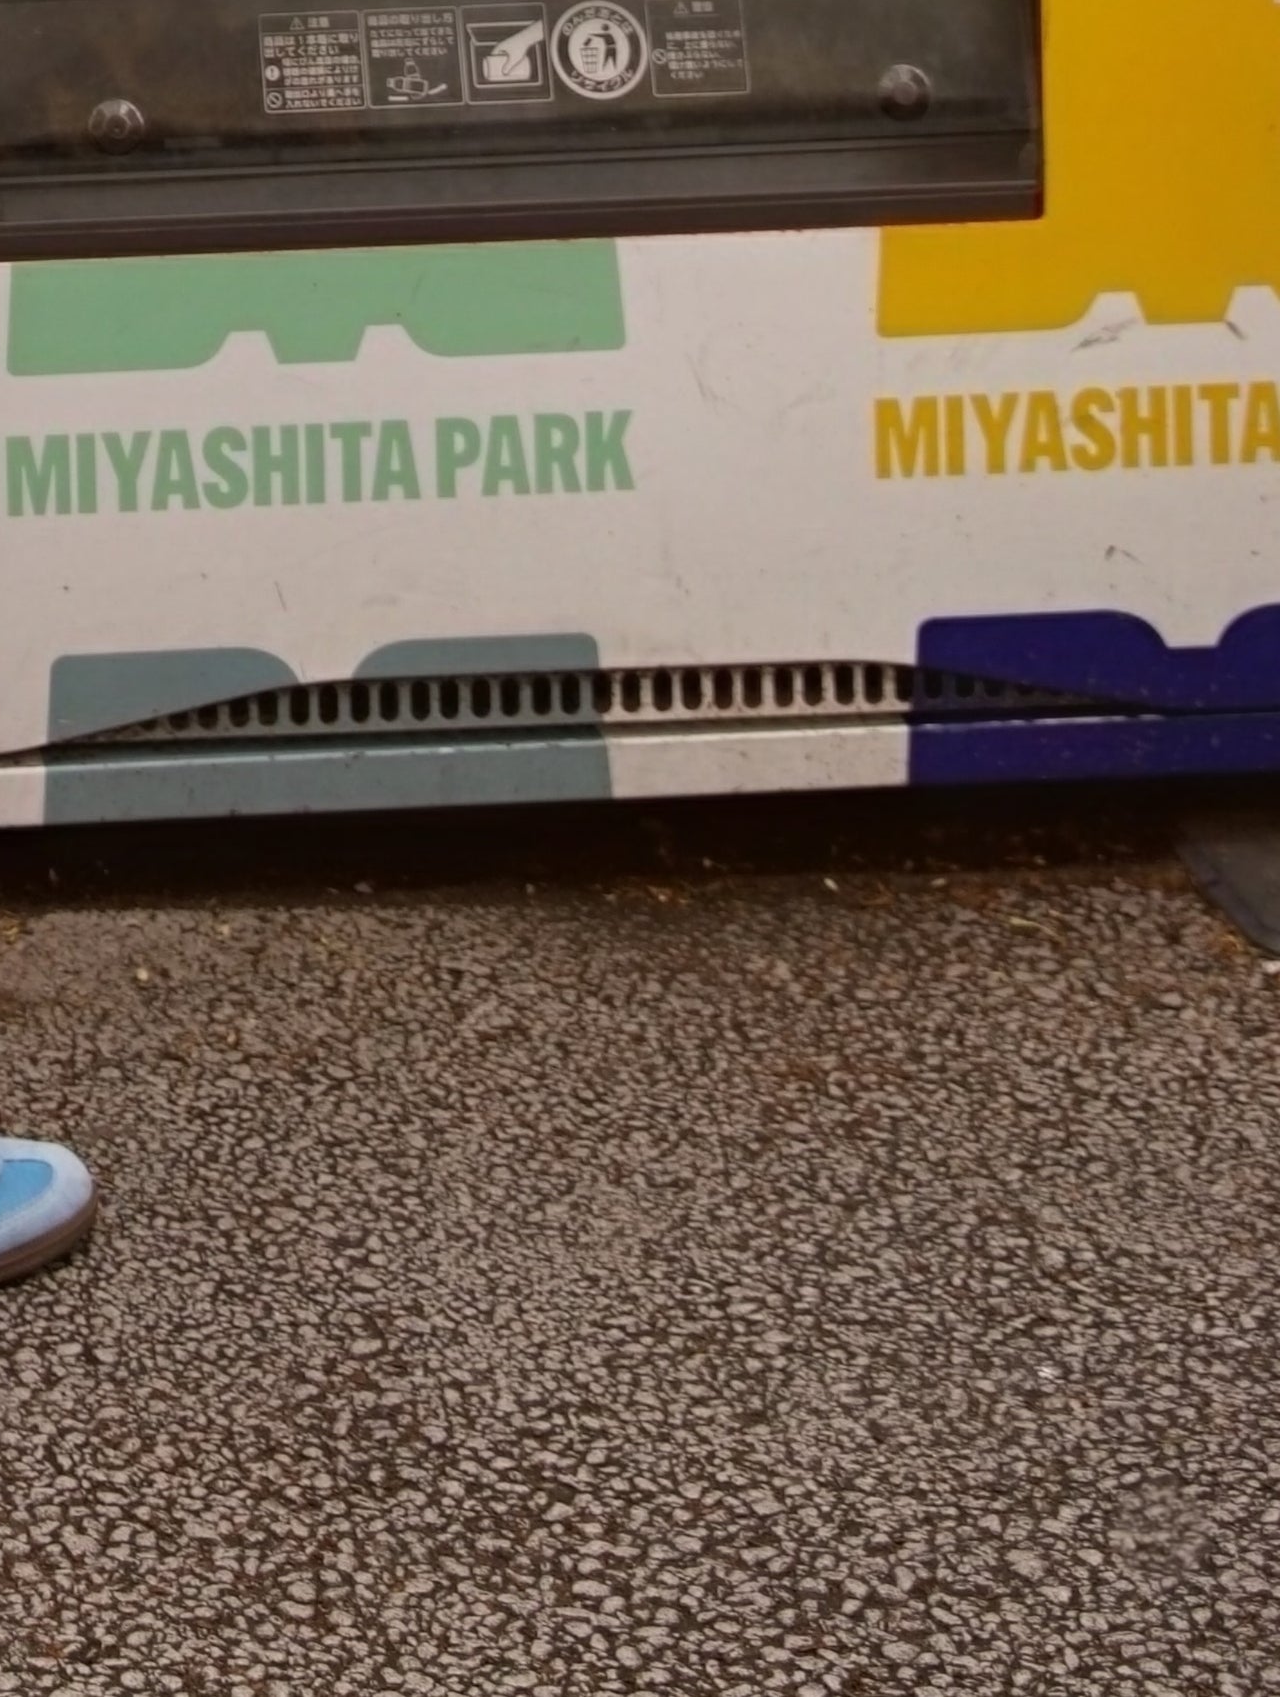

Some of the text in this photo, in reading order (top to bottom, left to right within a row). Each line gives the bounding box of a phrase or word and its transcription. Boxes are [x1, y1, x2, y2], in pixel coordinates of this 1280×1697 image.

[568, 68, 636, 94] リサイクル
[5, 409, 635, 517] MIYASHITA PARK
[873, 380, 1280, 479] MIYASHITA
